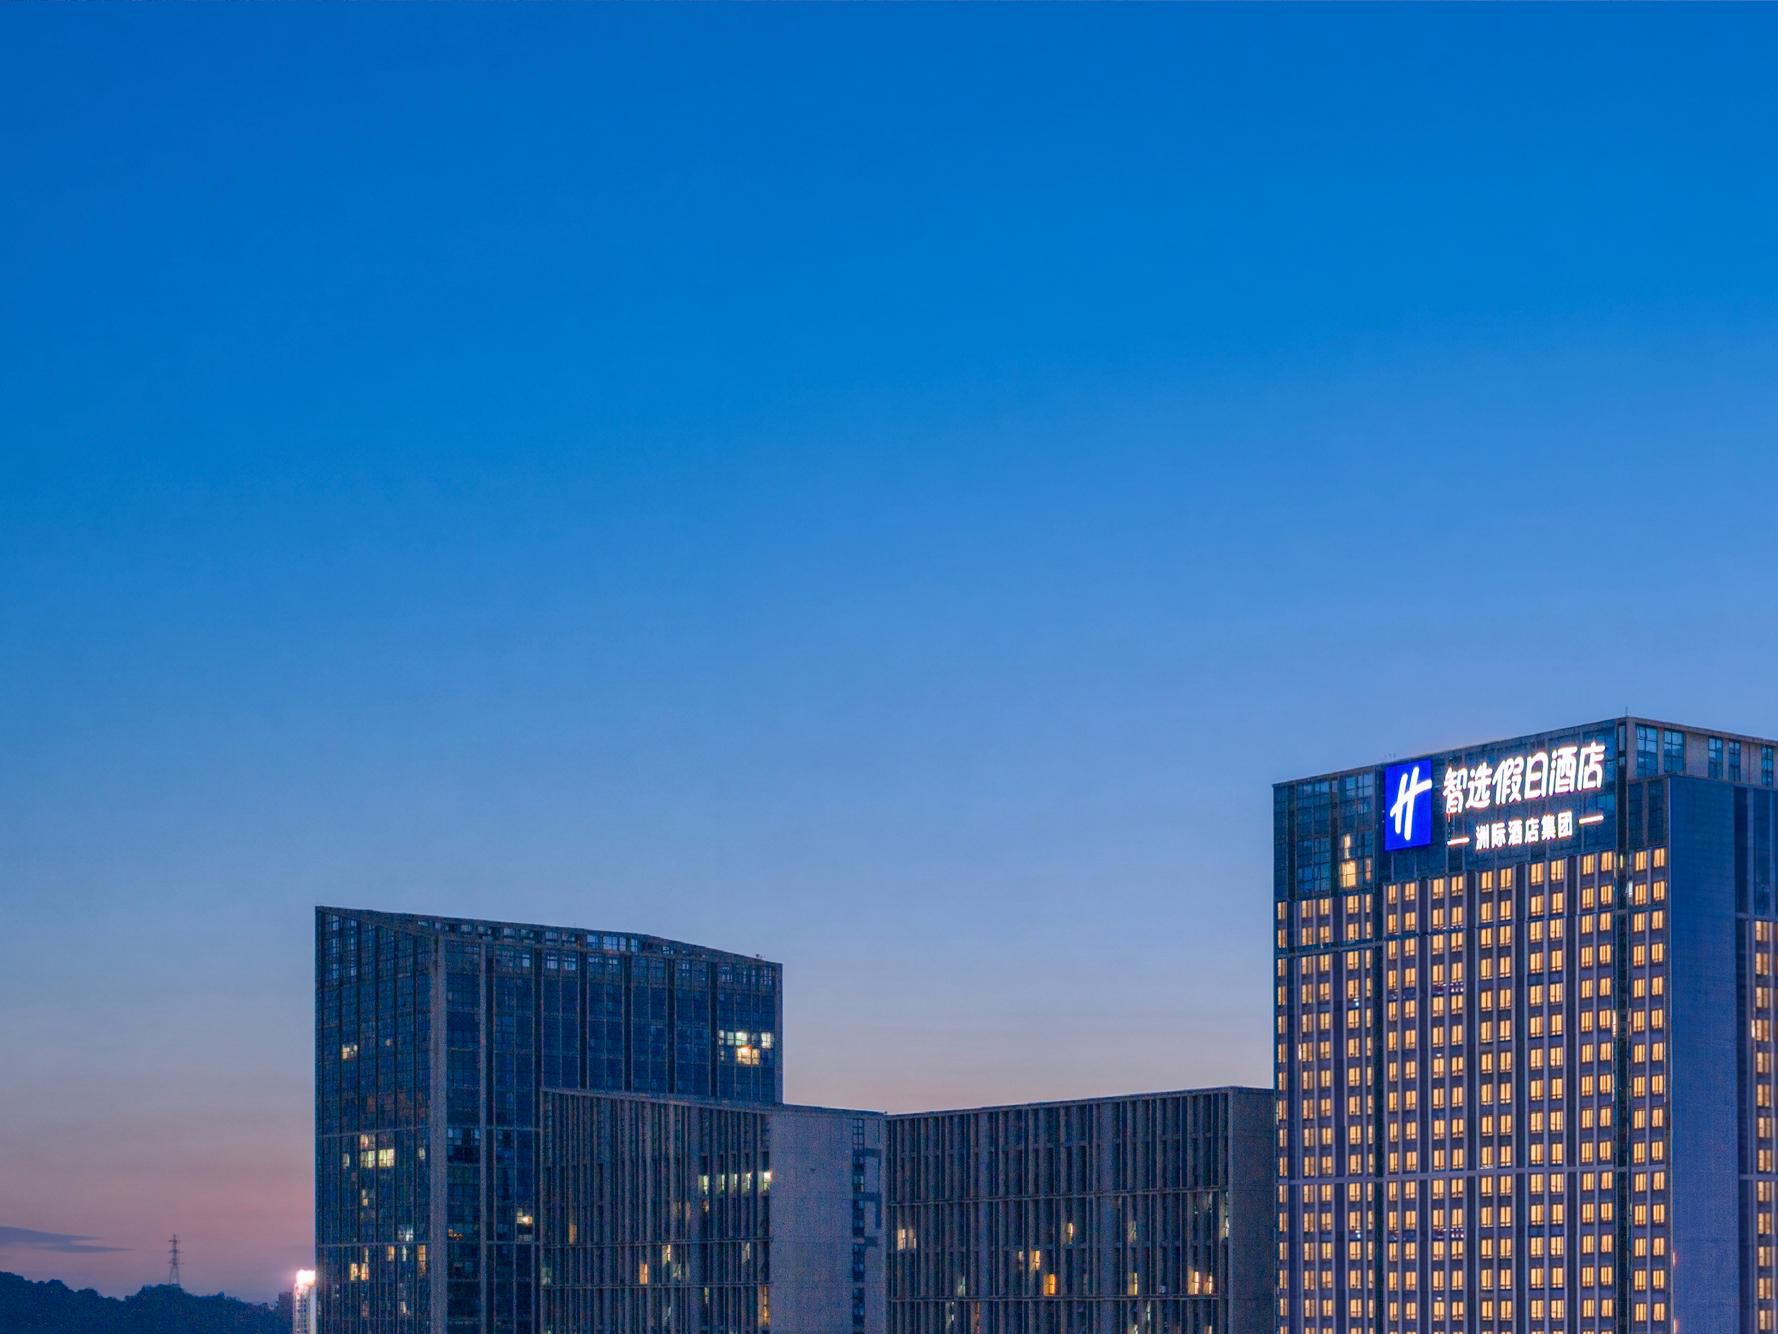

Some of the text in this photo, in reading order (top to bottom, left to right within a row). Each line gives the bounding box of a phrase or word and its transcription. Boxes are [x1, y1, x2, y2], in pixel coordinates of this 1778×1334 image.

[1443, 742, 1606, 814] 智选假日酒店
[1475, 811, 1573, 850] 洲际酒店集团
